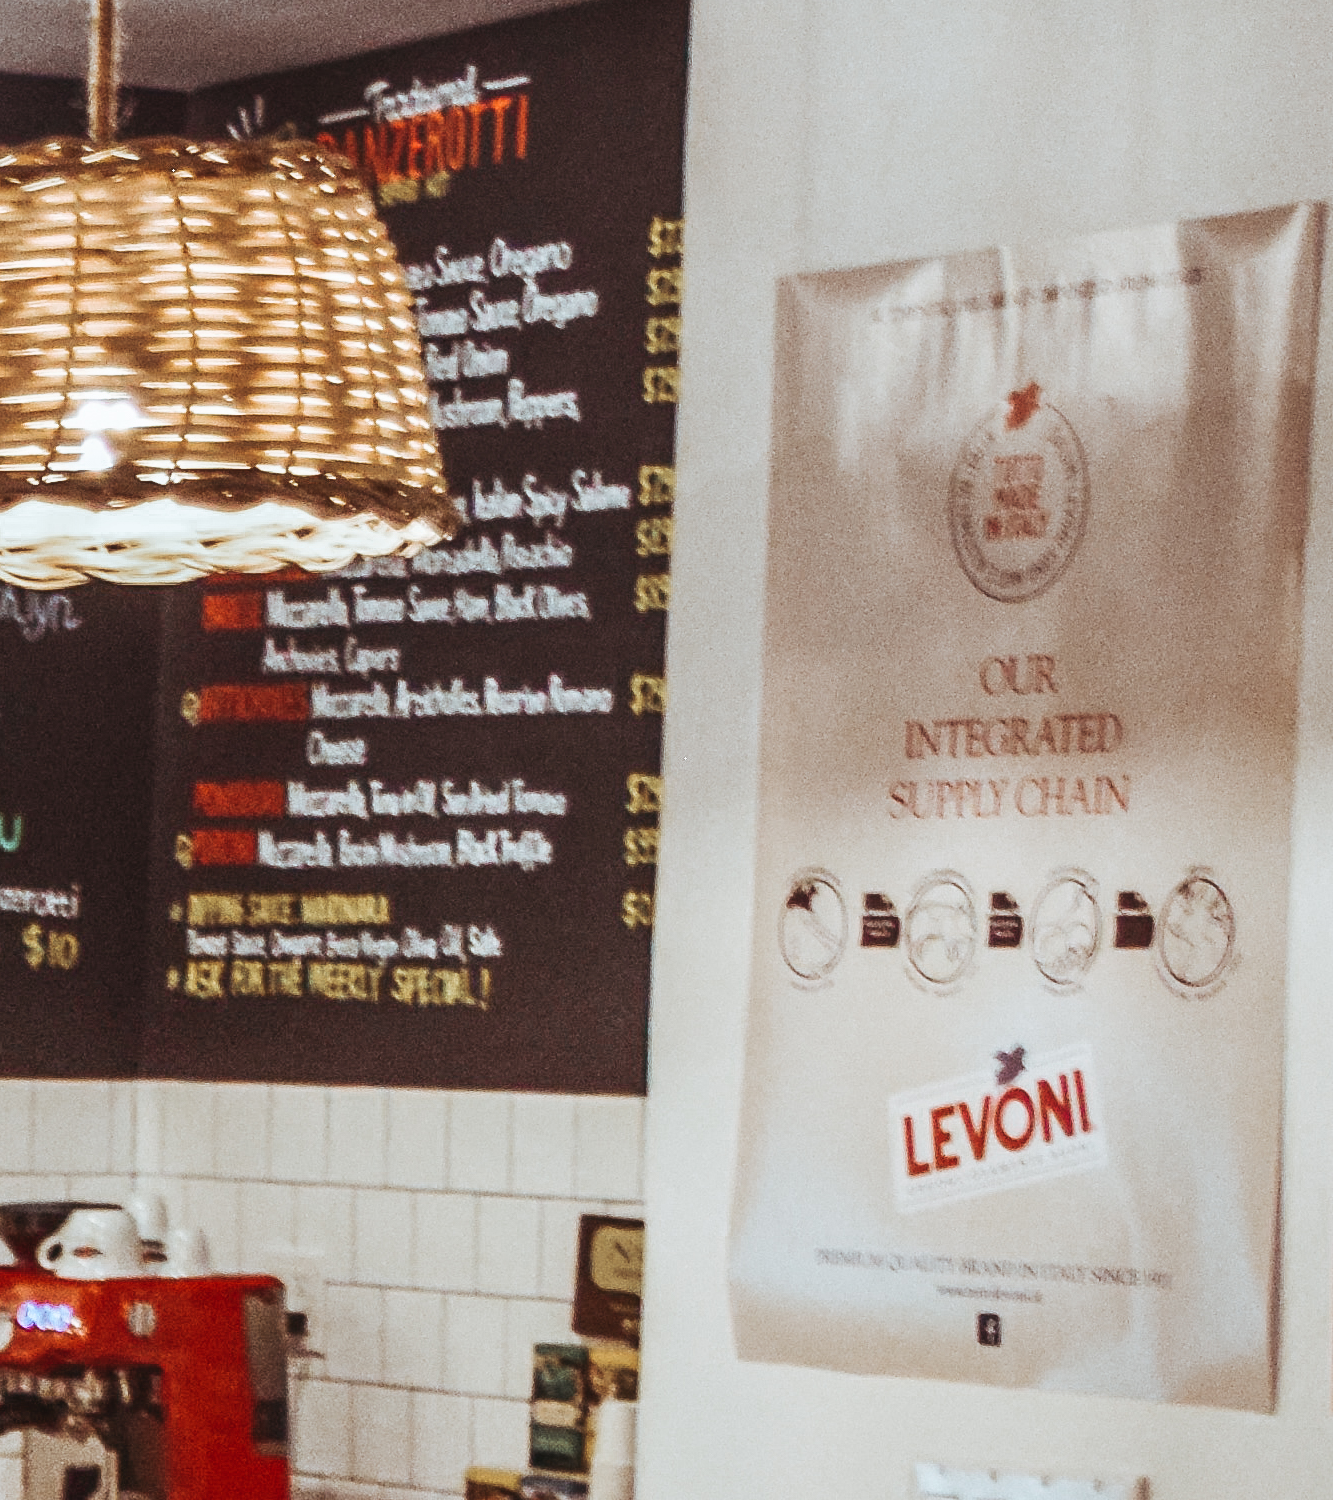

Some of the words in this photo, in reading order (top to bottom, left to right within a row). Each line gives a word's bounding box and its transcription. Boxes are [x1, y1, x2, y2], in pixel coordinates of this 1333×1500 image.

[978, 654, 1059, 697] OUR
[904, 711, 1124, 760] INTEGRATED
[888, 780, 1013, 819] SUPPLY
[1014, 776, 1131, 816] CHAIN
[22, 924, 80, 970] $10
[901, 1068, 1093, 1179] LEVONI
